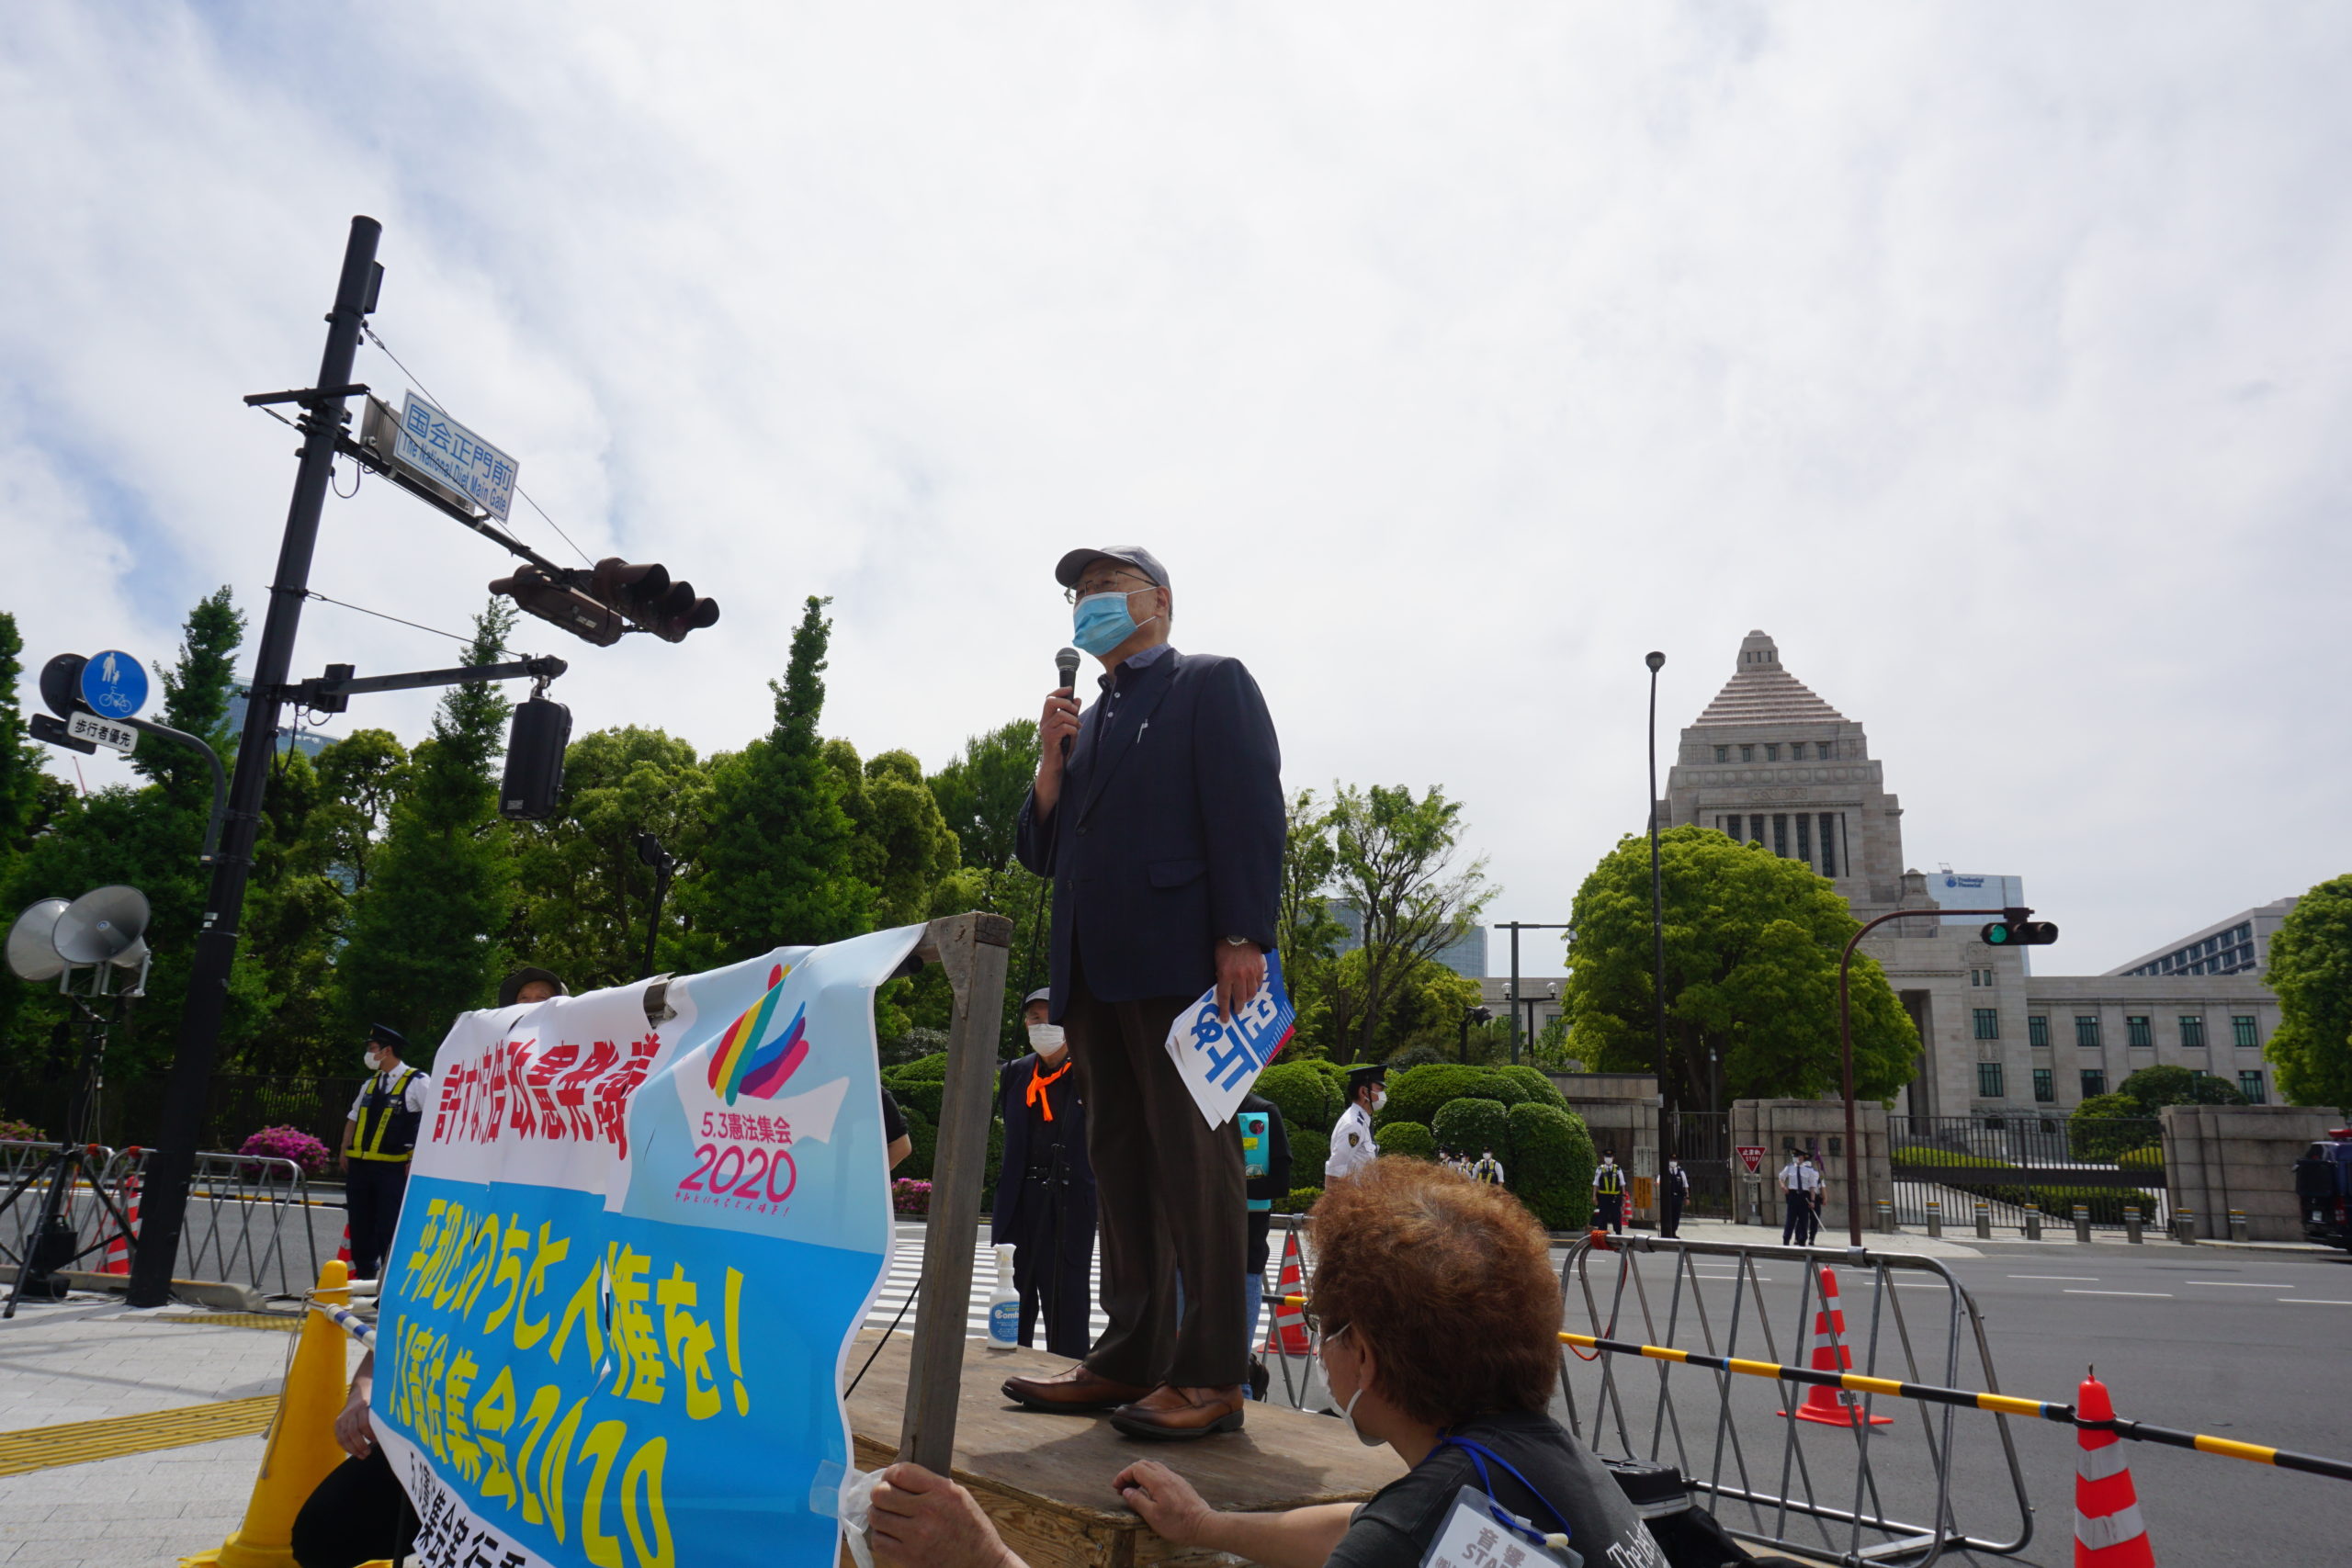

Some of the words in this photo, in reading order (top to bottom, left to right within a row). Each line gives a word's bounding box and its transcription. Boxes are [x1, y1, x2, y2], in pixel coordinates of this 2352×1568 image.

[402, 434, 418, 458] The
[419, 446, 454, 483] National
[455, 465, 470, 490] Diet
[470, 474, 489, 502] Main
[490, 488, 506, 513] Gate
[407, 403, 514, 491] 国会正門前
[74, 719, 131, 748] 歩行者優先
[1190, 989, 1259, 1093] 止め
[701, 1111, 793, 1145] 5.3憲法集会
[678, 1143, 797, 1203] 2020
